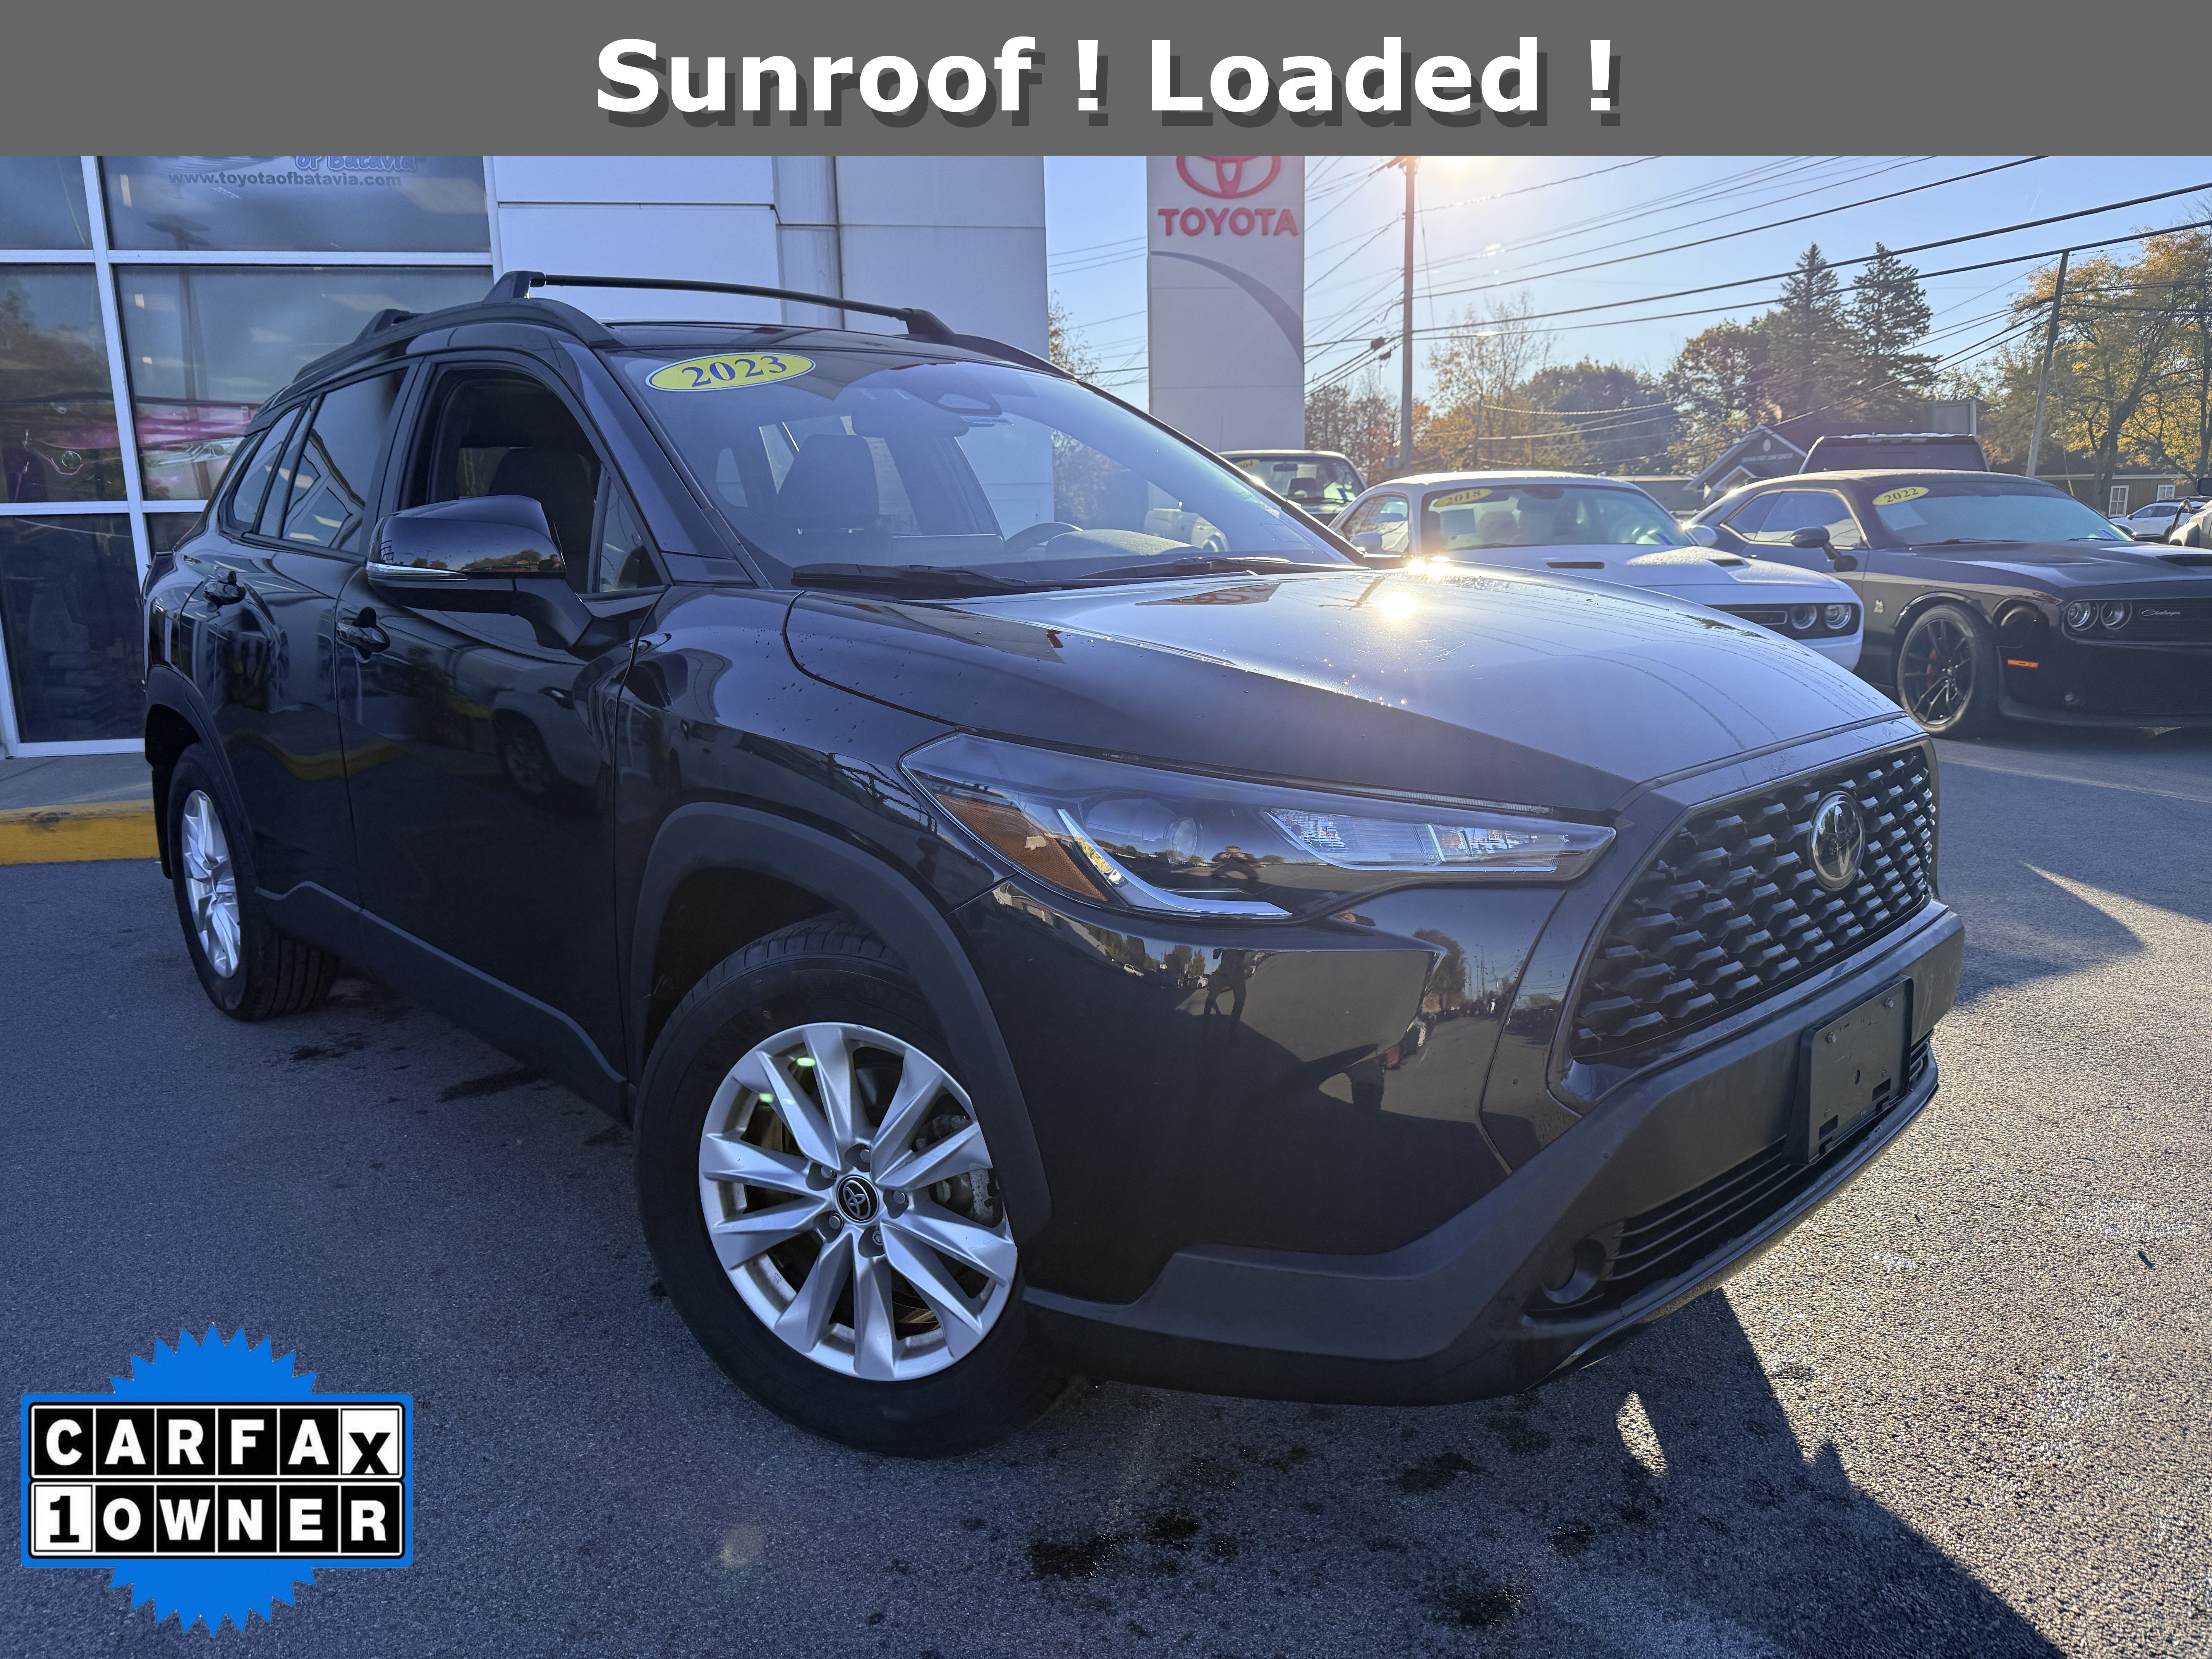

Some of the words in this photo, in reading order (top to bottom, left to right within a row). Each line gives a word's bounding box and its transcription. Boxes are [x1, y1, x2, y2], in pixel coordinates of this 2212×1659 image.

[168, 172, 402, 187] www.toyotaofbatavia.com
[1157, 207, 1299, 236] TOYOTA
[681, 355, 787, 388] 2023
[1446, 489, 1481, 504] 2018
[1884, 488, 1918, 503] 2022
